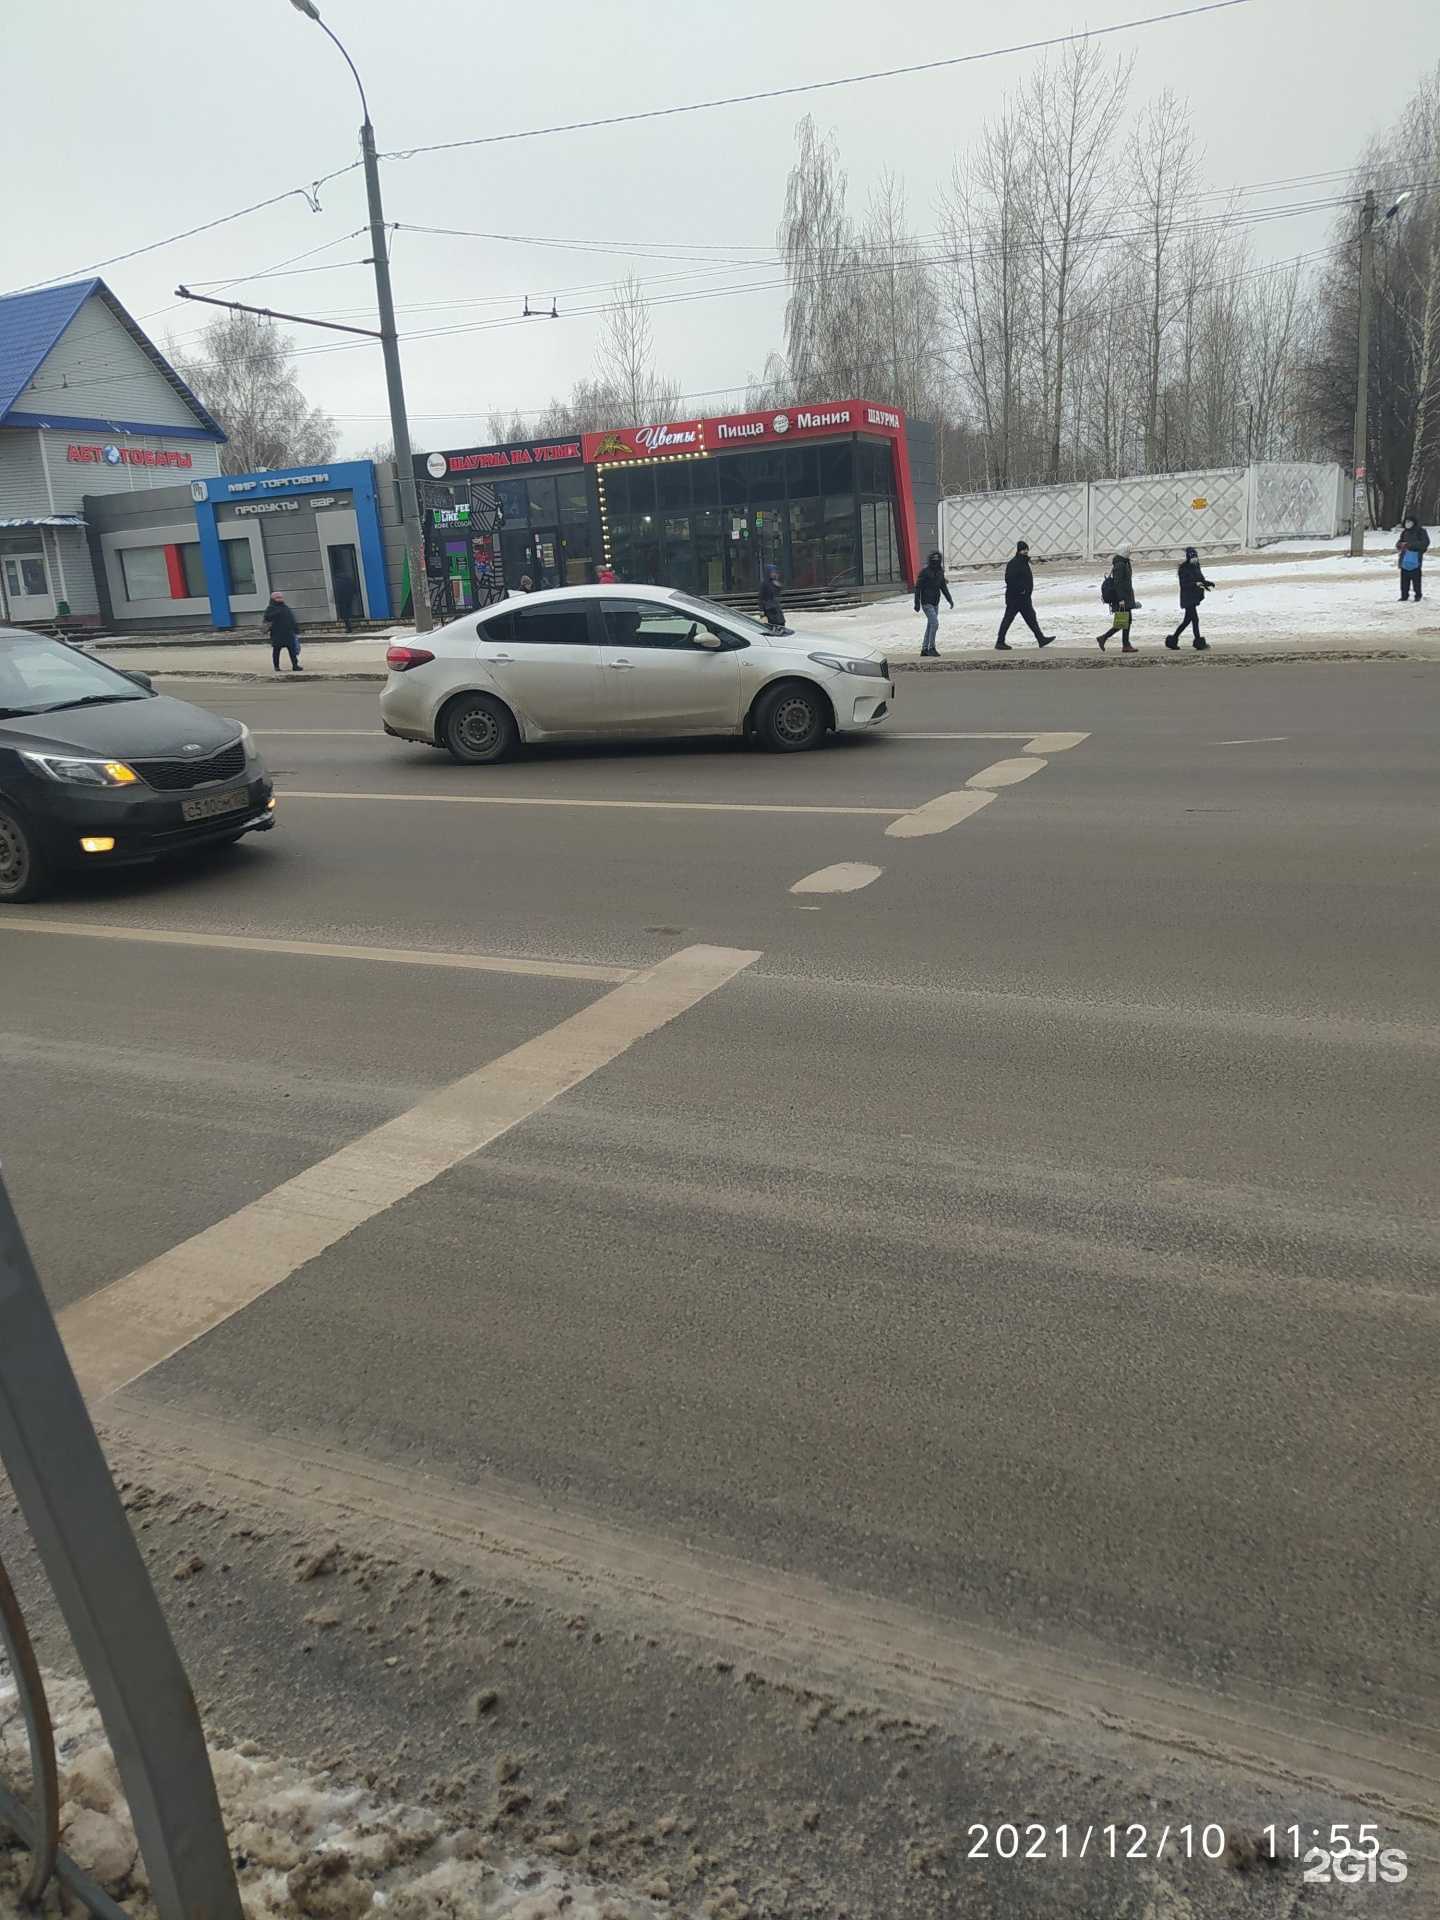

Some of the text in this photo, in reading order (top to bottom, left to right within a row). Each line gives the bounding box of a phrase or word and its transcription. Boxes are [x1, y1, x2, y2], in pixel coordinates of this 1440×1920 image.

[717, 421, 765, 440] Пицца
[797, 410, 850, 429] Мания
[867, 407, 900, 429] ШАУРМА
[635, 426, 697, 454] Цветы
[228, 473, 329, 493] МИР ТОРГОВЛИ
[235, 500, 299, 515] ПРОДУКТЫ
